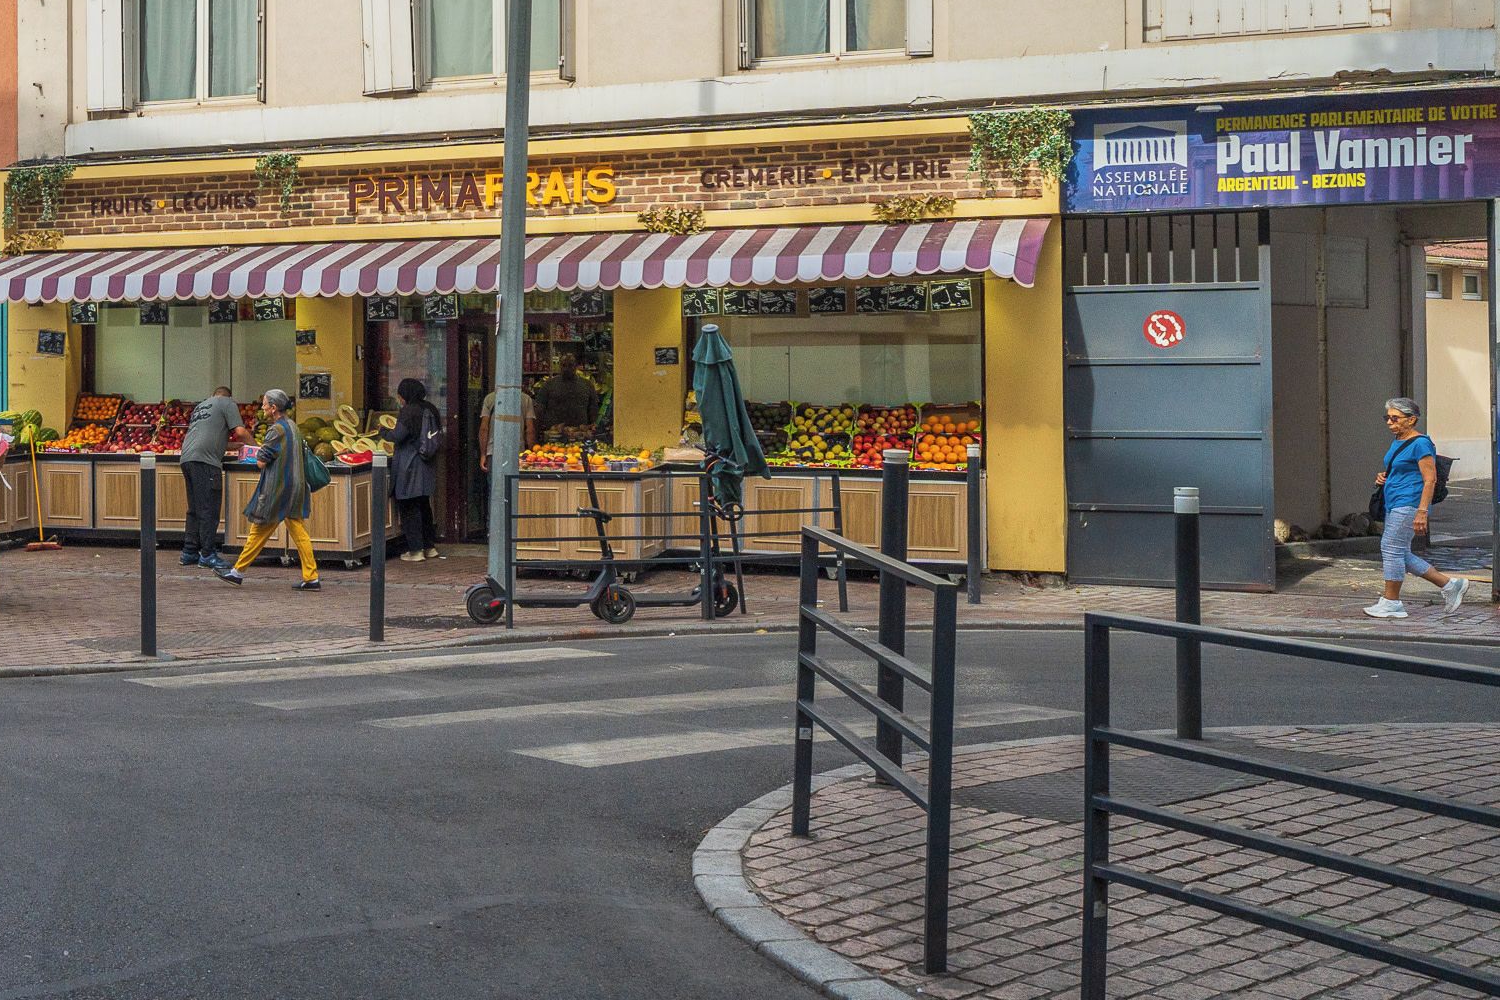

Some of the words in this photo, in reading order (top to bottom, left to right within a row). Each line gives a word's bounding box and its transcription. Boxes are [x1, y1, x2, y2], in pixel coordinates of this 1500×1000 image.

[1216, 113, 1306, 132] PERMANENCE
[1310, 107, 1423, 127] PARLEMENTAIRE
[1428, 106, 1447, 122] DE
[1451, 103, 1498, 121] VOTRE
[1216, 131, 1301, 174] Paul
[1314, 127, 1473, 170] Vannier
[700, 164, 817, 188] CRÈMERIE
[841, 158, 952, 183] ÉPICERIE
[1093, 167, 1188, 184] ASSEMBLÉE
[1217, 176, 1299, 193] ARGENTEUIL
[1312, 173, 1366, 190] BEZONS
[1093, 182, 1188, 197] NATIONALE
[90, 195, 152, 215] FRUITS
[172, 191, 258, 212] LÉGUMES
